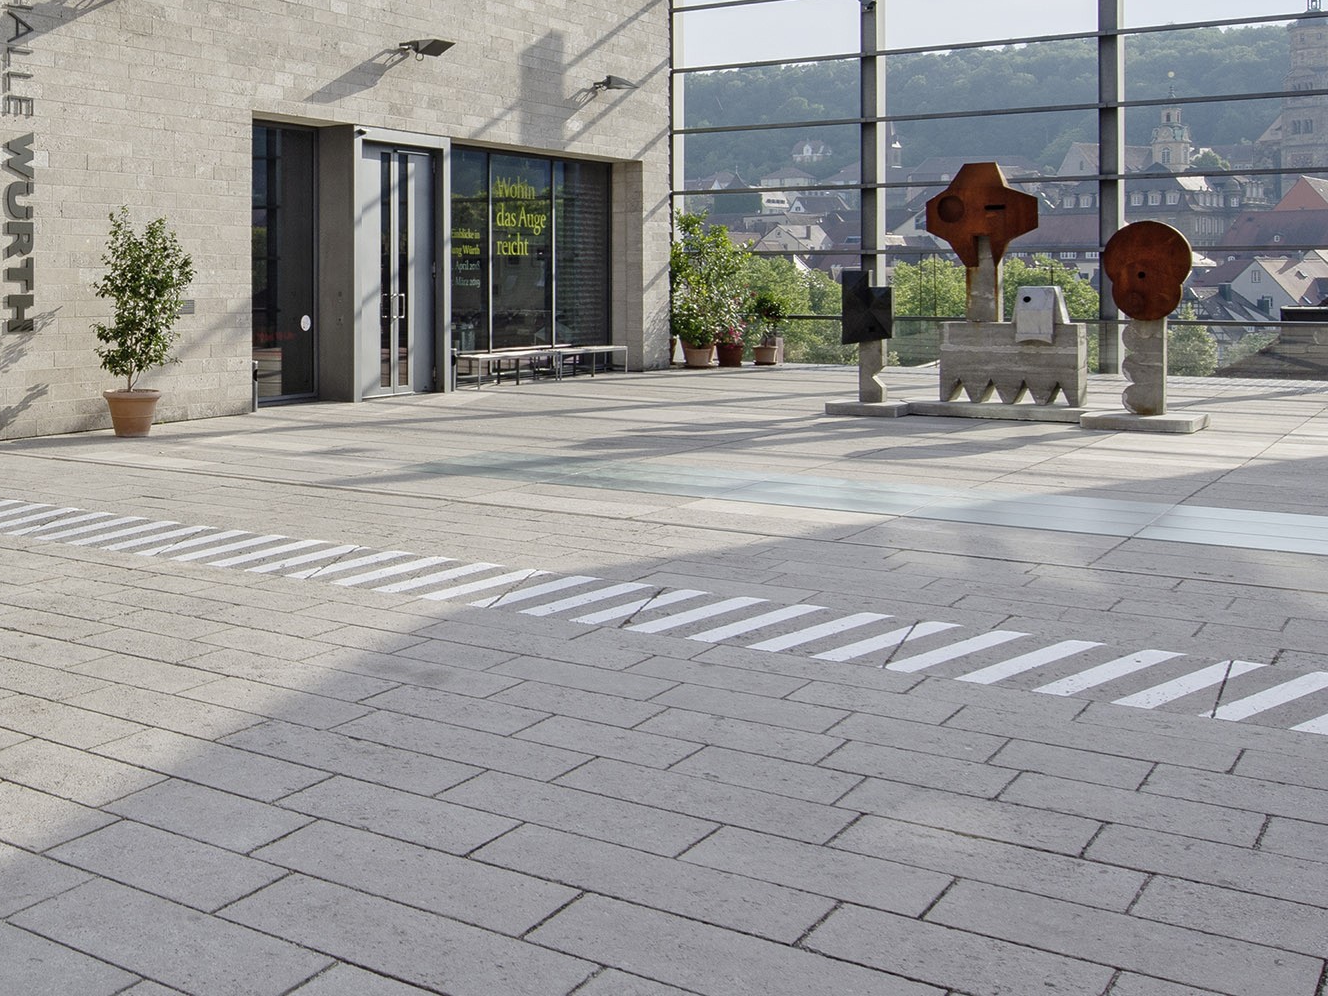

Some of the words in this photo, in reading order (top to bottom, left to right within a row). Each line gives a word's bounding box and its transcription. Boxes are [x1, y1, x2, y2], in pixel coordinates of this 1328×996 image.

[495, 175, 535, 199] Wohin
[496, 204, 516, 227] das
[518, 207, 546, 235] Auge
[496, 234, 529, 256] reicht
